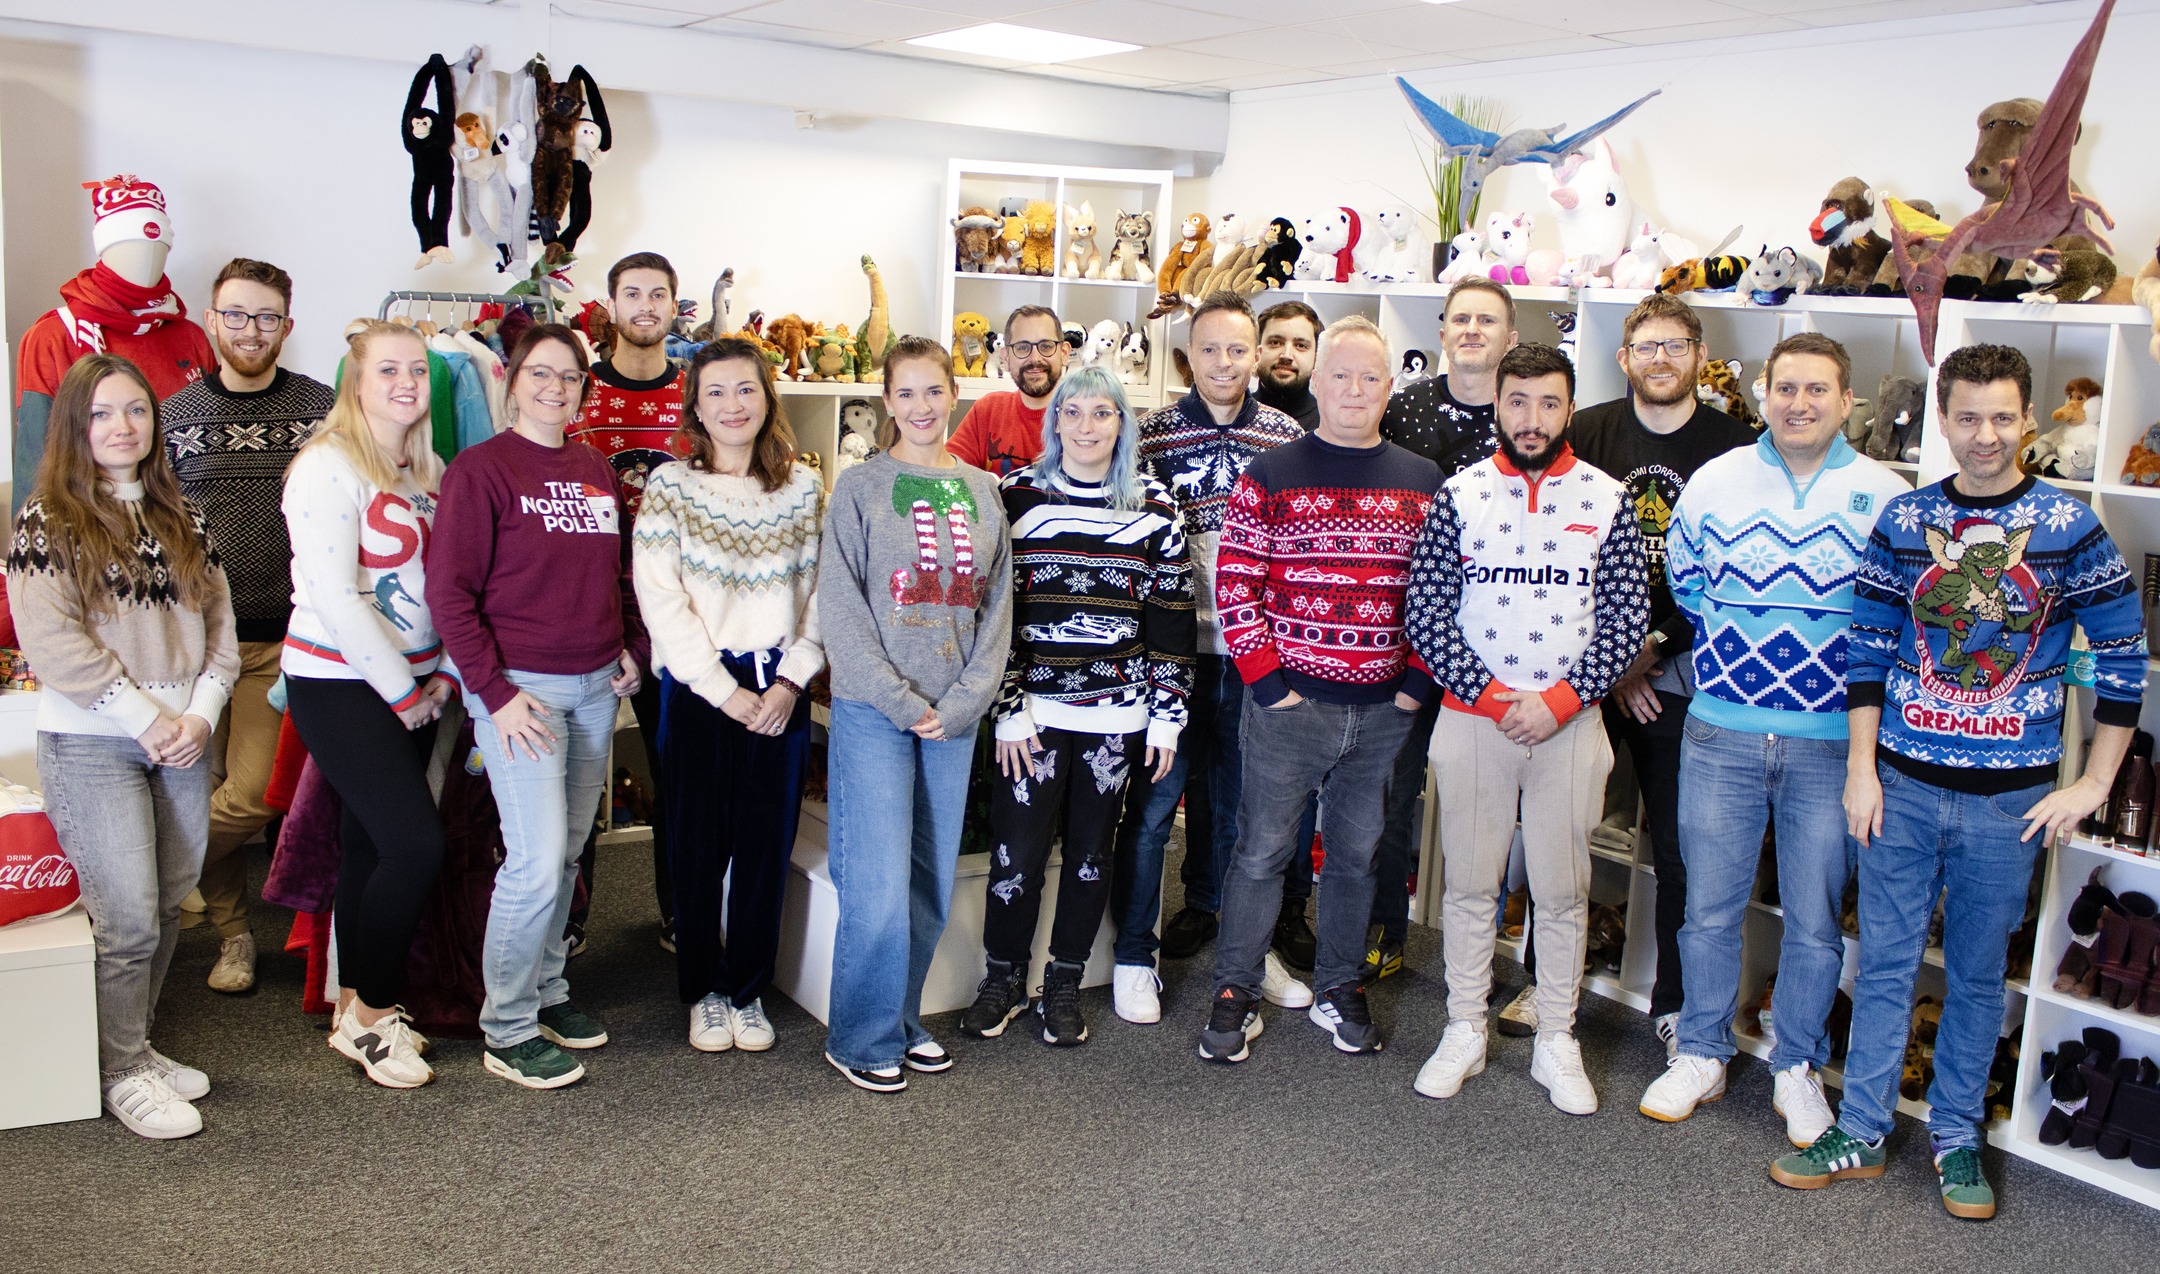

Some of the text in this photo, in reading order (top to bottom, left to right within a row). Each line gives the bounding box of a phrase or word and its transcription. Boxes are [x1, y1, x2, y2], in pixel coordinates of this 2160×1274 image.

[658, 414, 677, 423] HO
[544, 481, 585, 499] THE
[520, 495, 592, 516] NORTH
[543, 515, 599, 533] POLE
[1305, 557, 1369, 568] RACING
[1463, 564, 1590, 587] Formula 1
[1298, 582, 1333, 591] FOR
[1925, 676, 1953, 698] FEED
[1953, 689, 1989, 702] AFTER
[6, 854, 33, 862] DRINK
[0, 854, 73, 890] ca-Cola
